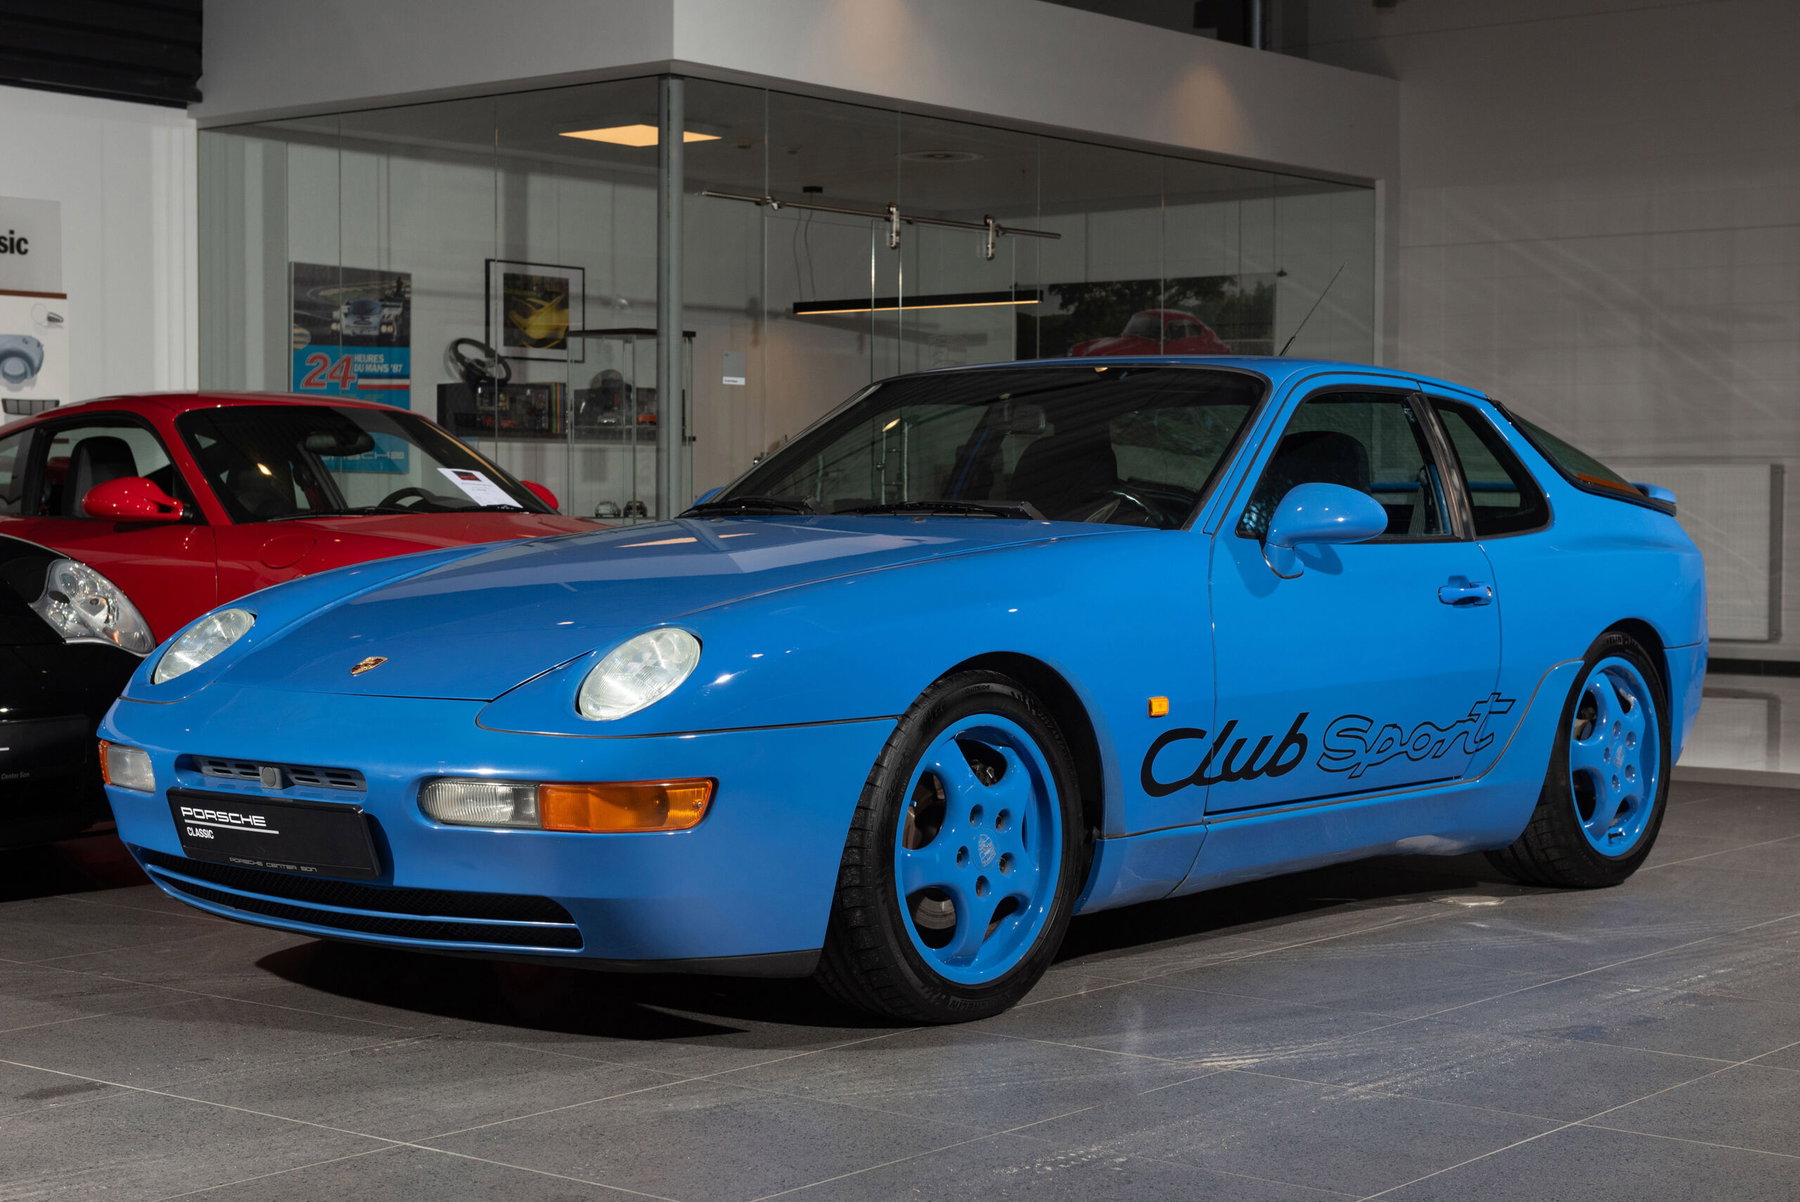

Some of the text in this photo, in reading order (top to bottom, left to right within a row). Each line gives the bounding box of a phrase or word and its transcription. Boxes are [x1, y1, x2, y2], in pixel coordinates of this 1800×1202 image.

[0, 229, 29, 255] sic
[353, 354, 384, 363] HEURES
[353, 363, 364, 372] DU
[365, 364, 389, 372] MANS
[301, 352, 357, 390] 24
[1140, 712, 1310, 797] Club
[1316, 692, 1516, 779] Sport
[180, 806, 267, 827] PORSCHE
[186, 826, 215, 839] CLASSIC
